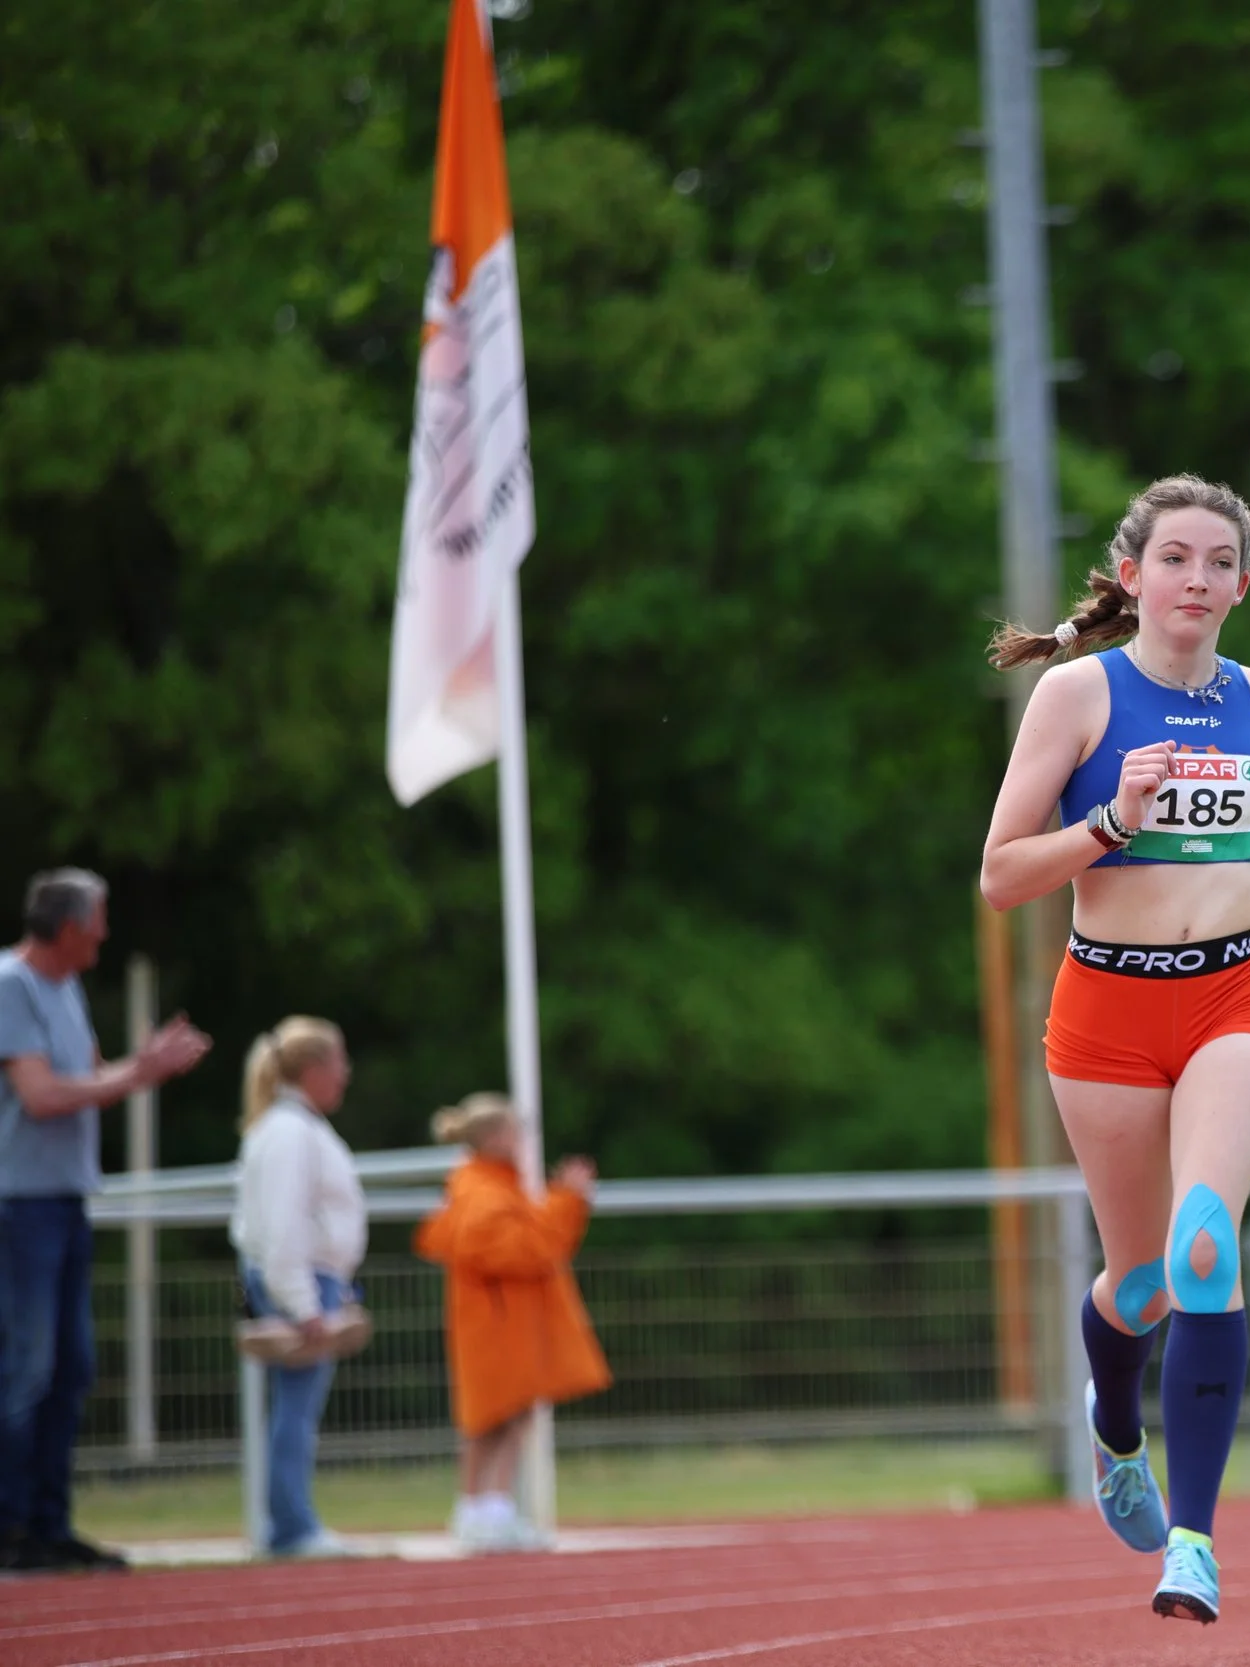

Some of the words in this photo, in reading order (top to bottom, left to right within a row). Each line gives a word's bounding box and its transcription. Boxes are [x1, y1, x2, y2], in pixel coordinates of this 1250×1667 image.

[1164, 715, 1209, 726] CRAFT
[1156, 788, 1245, 827] 185
[1116, 950, 1206, 972] PRO
